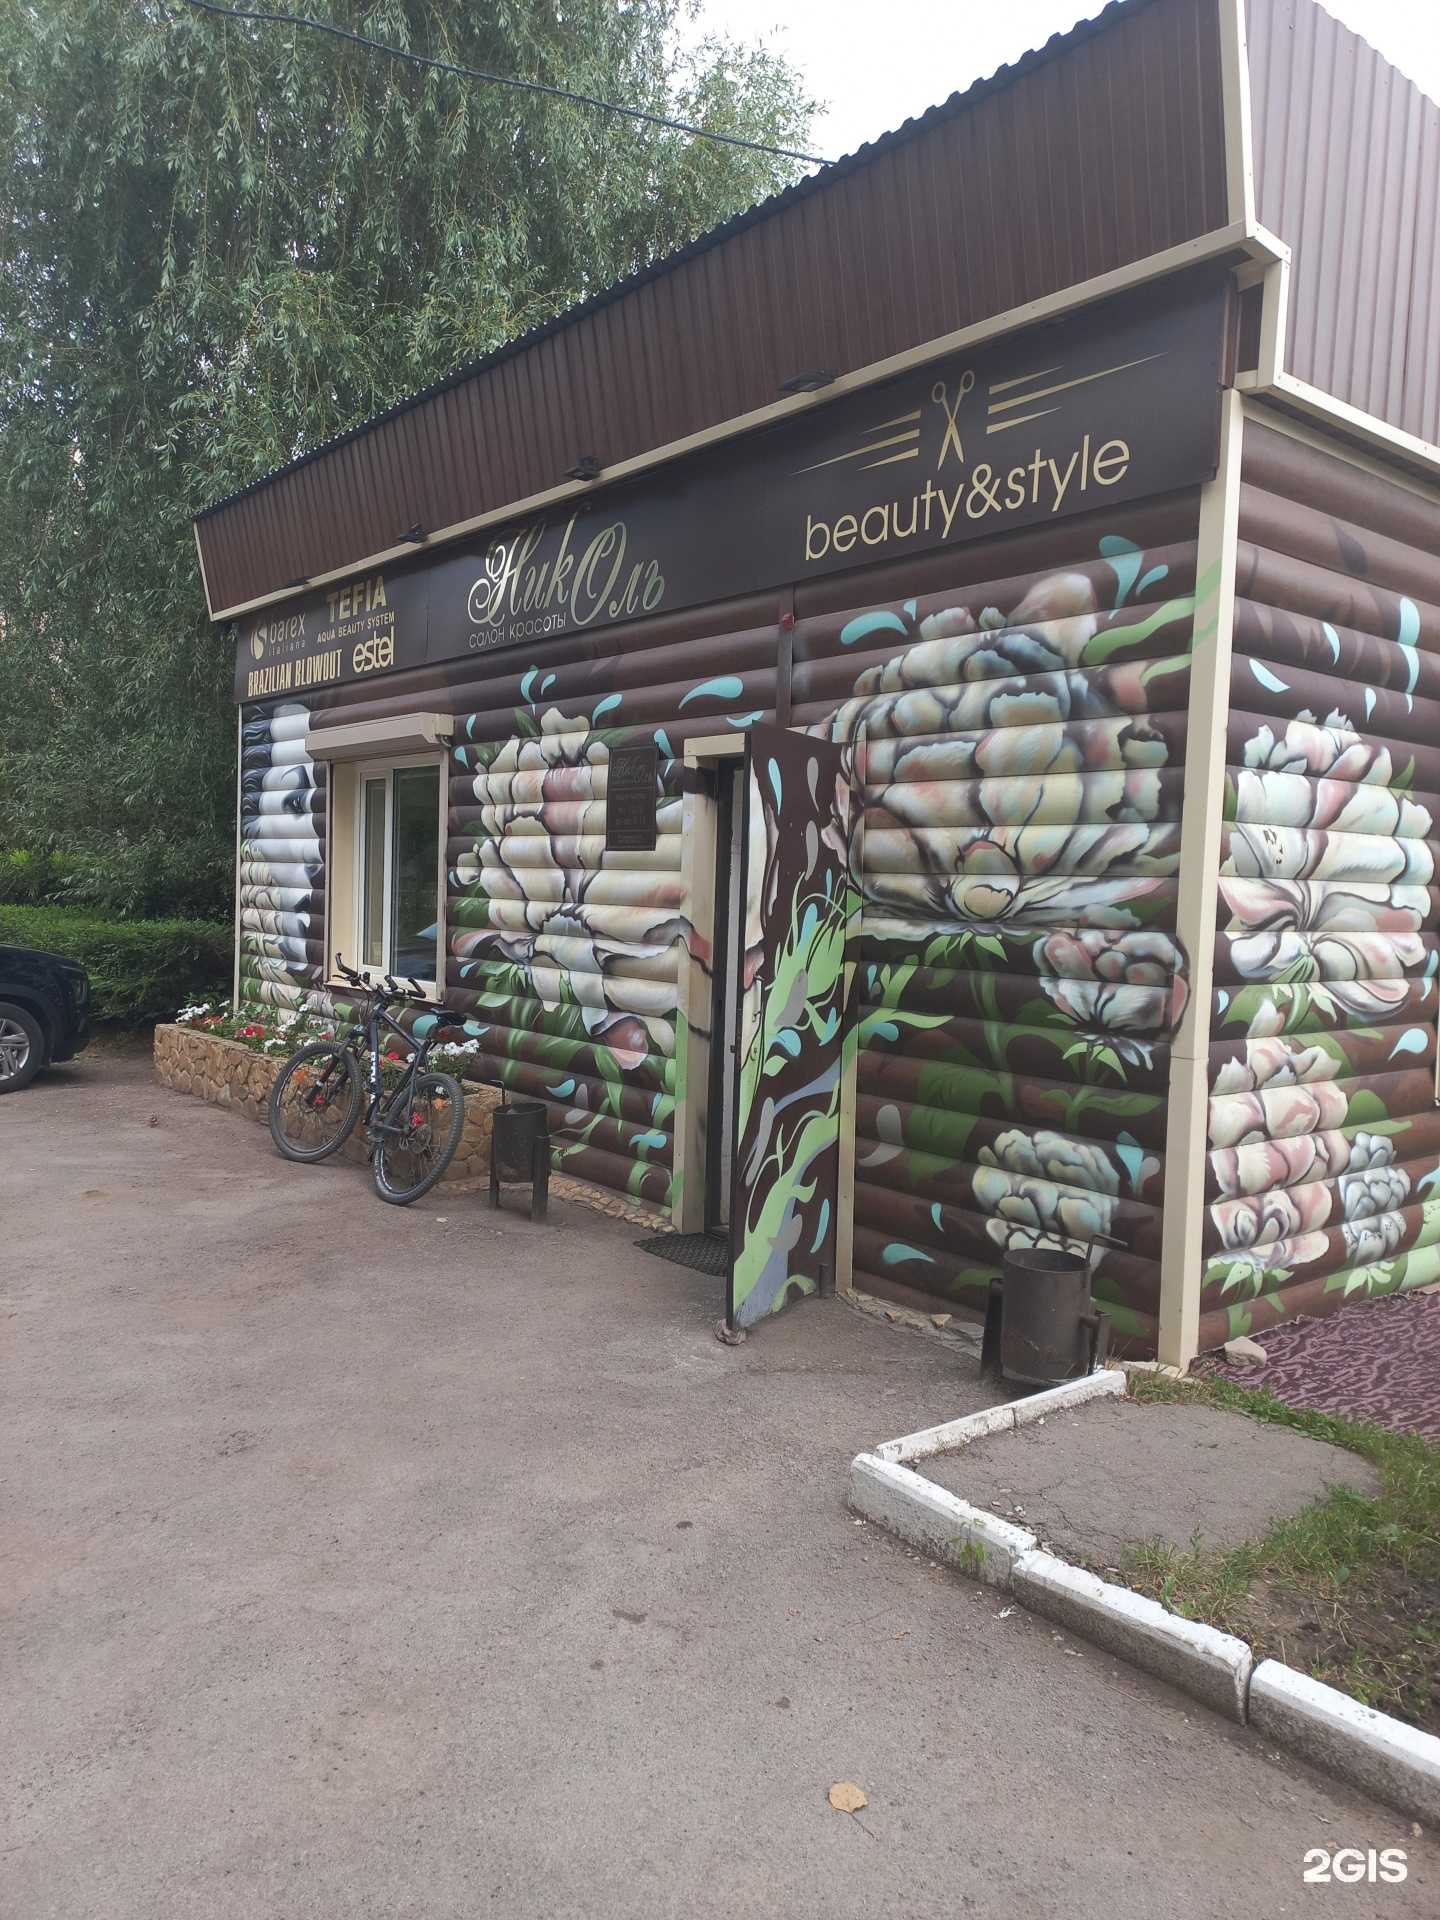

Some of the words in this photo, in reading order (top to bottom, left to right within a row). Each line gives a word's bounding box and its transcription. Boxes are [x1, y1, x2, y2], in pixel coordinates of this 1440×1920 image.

[804, 433, 1131, 561] beauty&style
[327, 575, 387, 623] TEFIA
[316, 628, 336, 644] AQUA
[338, 620, 365, 637] BEAUTY
[366, 611, 395, 629] SYSTEM
[352, 625, 395, 673] estel
[469, 627, 505, 649] салон
[508, 612, 567, 644] красоты
[247, 661, 291, 697] BRAZILIAN
[294, 649, 343, 687] BLOWOUT
